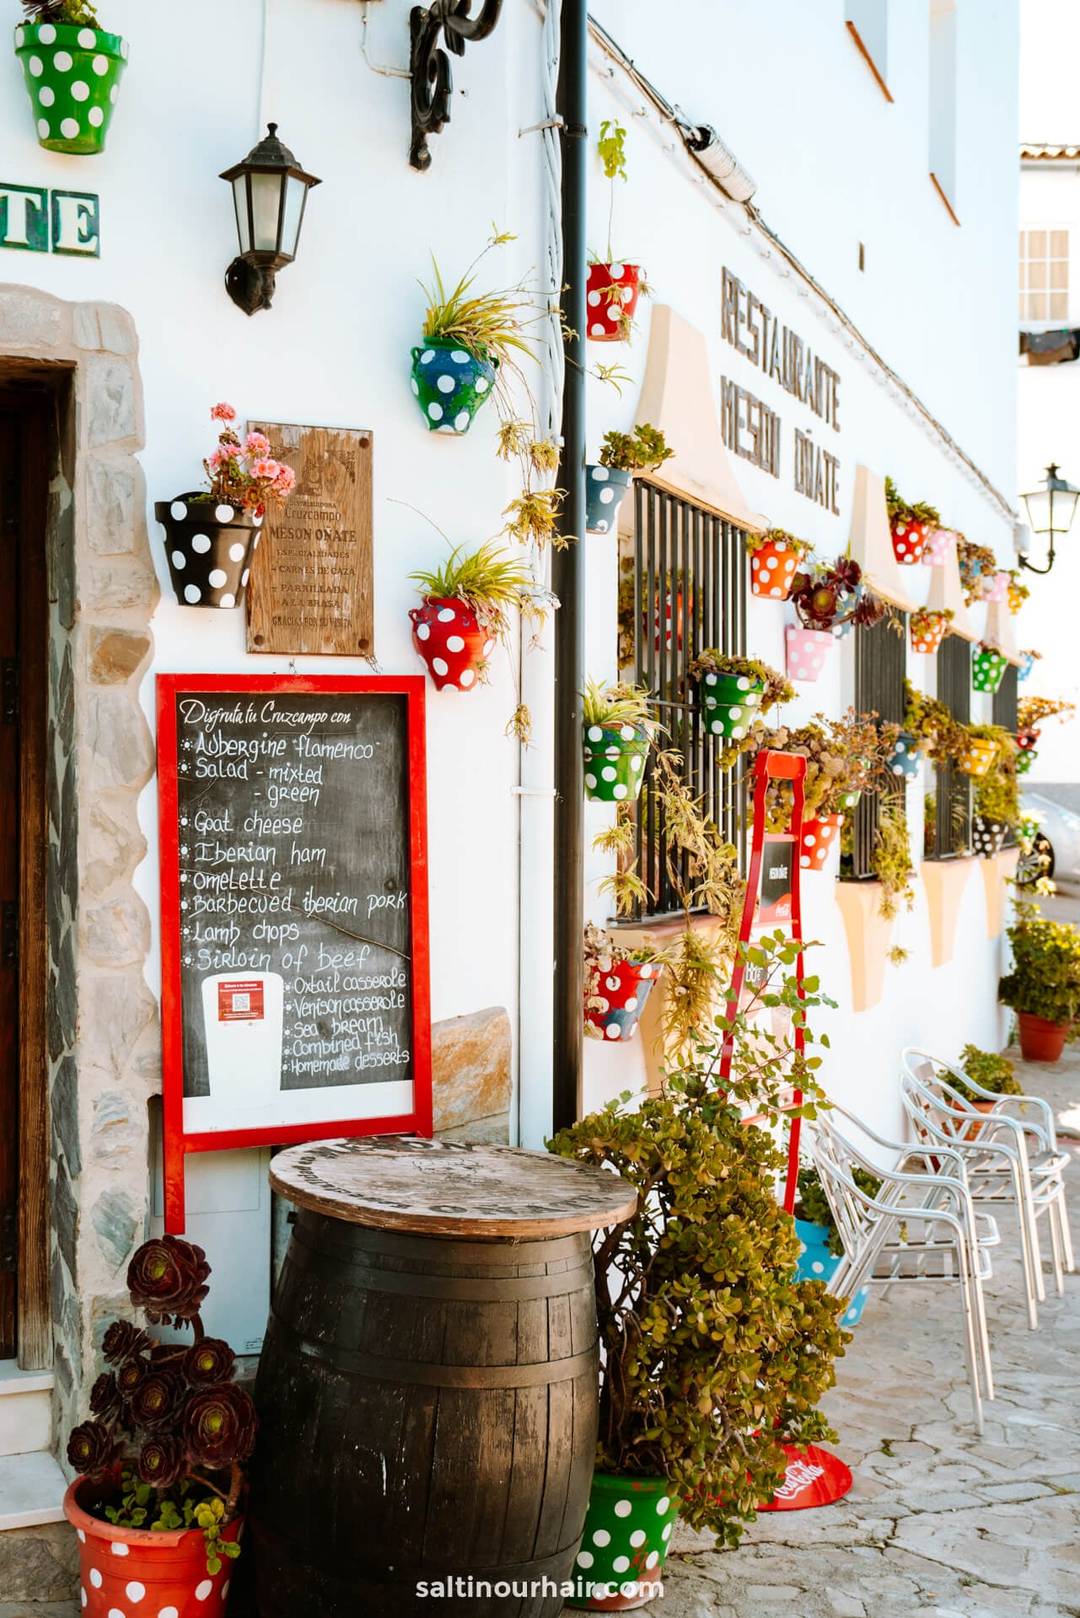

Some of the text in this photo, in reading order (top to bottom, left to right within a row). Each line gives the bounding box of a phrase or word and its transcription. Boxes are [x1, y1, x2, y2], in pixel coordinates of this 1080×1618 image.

[0, 188, 98, 252] TE
[721, 265, 841, 433] RESTAURANTE
[720, 375, 840, 516] MESON OÑATE
[285, 508, 341, 521] Cruzcampo
[270, 526, 356, 542] MESON OÑATE
[179, 699, 352, 735] Disfruta tu Cruzcampo con
[196, 729, 287, 763] Aubergine
[196, 758, 323, 785] Salad mixed
[267, 785, 320, 808] green
[194, 810, 303, 837] Goat cheese
[194, 841, 326, 867] Iberian ham
[188, 888, 292, 918] Barbecued
[367, 891, 408, 919] pork
[193, 920, 300, 947] Lamb chops
[197, 942, 370, 972] Sirloin of beef
[294, 967, 406, 994] Oxtail casserole
[294, 998, 342, 1019] Venison
[294, 1016, 384, 1039] Sea bream
[293, 1026, 400, 1057] Combined fish
